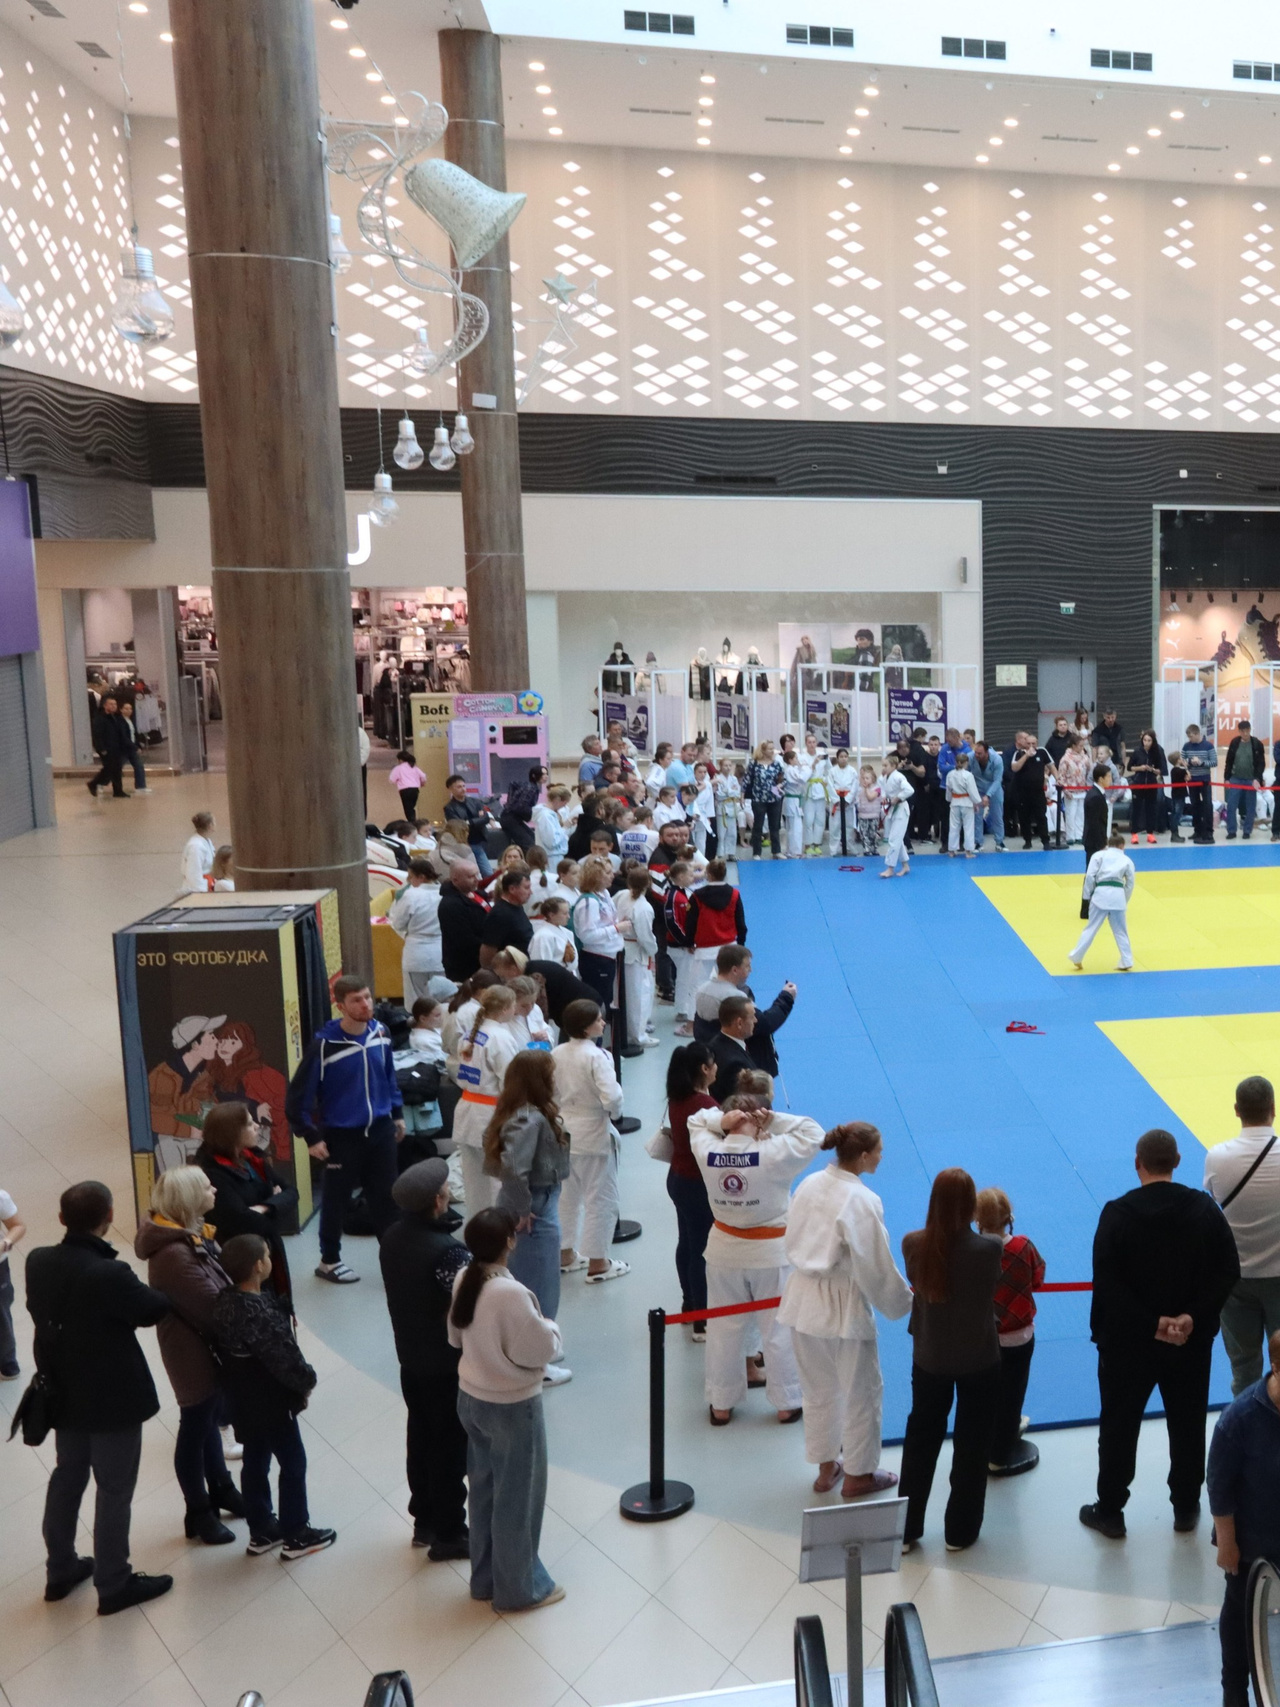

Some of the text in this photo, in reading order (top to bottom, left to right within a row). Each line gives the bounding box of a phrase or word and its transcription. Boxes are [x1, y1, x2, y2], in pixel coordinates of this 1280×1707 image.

[420, 704, 450, 715] Boft
[137, 949, 269, 967] ЭТО ФОТОБУДКА
